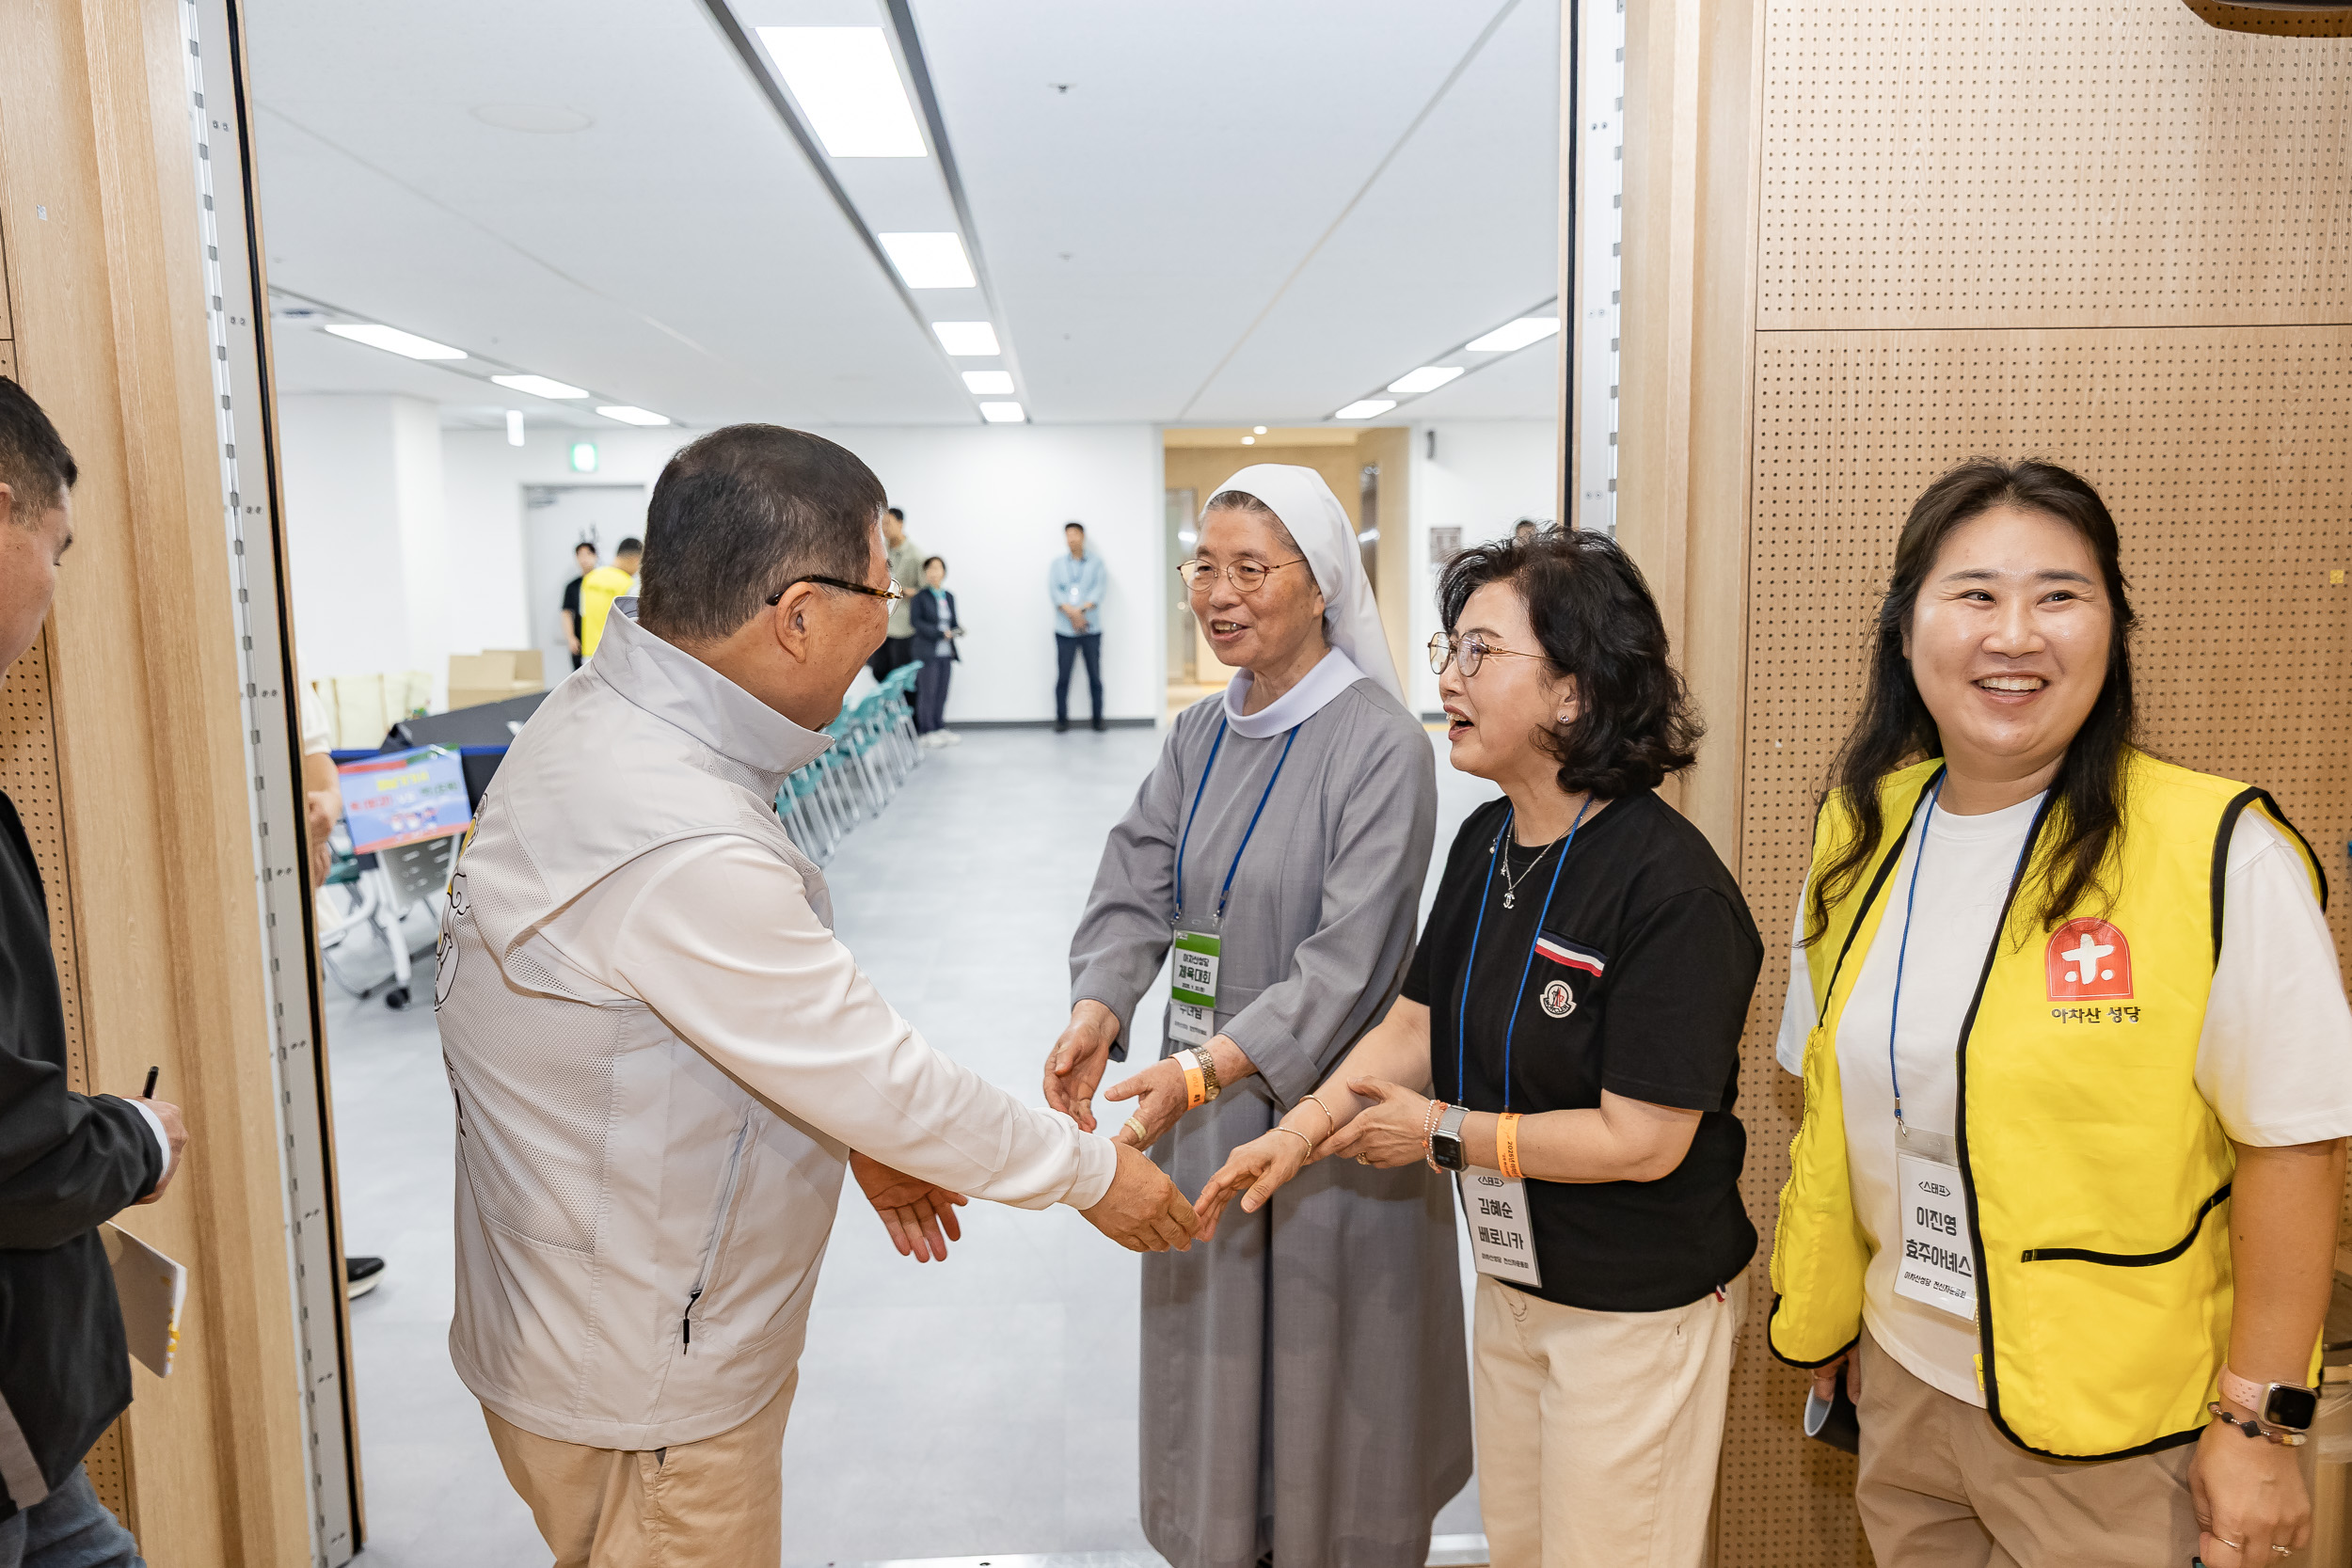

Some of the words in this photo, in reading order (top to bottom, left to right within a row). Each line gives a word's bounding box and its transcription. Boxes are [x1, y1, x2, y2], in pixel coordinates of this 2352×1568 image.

[1178, 964, 1211, 984] 체육대회
[2051, 1007, 2101, 1023] 아차산
[2106, 1006, 2141, 1023] 성당
[1478, 1197, 1513, 1219] 김혜순
[1916, 1206, 1957, 1236] 이진영
[1478, 1226, 1524, 1250] 베로니카
[1905, 1239, 1972, 1277] 효주아녜스
[1904, 1272, 1931, 1287] 아차산성당
